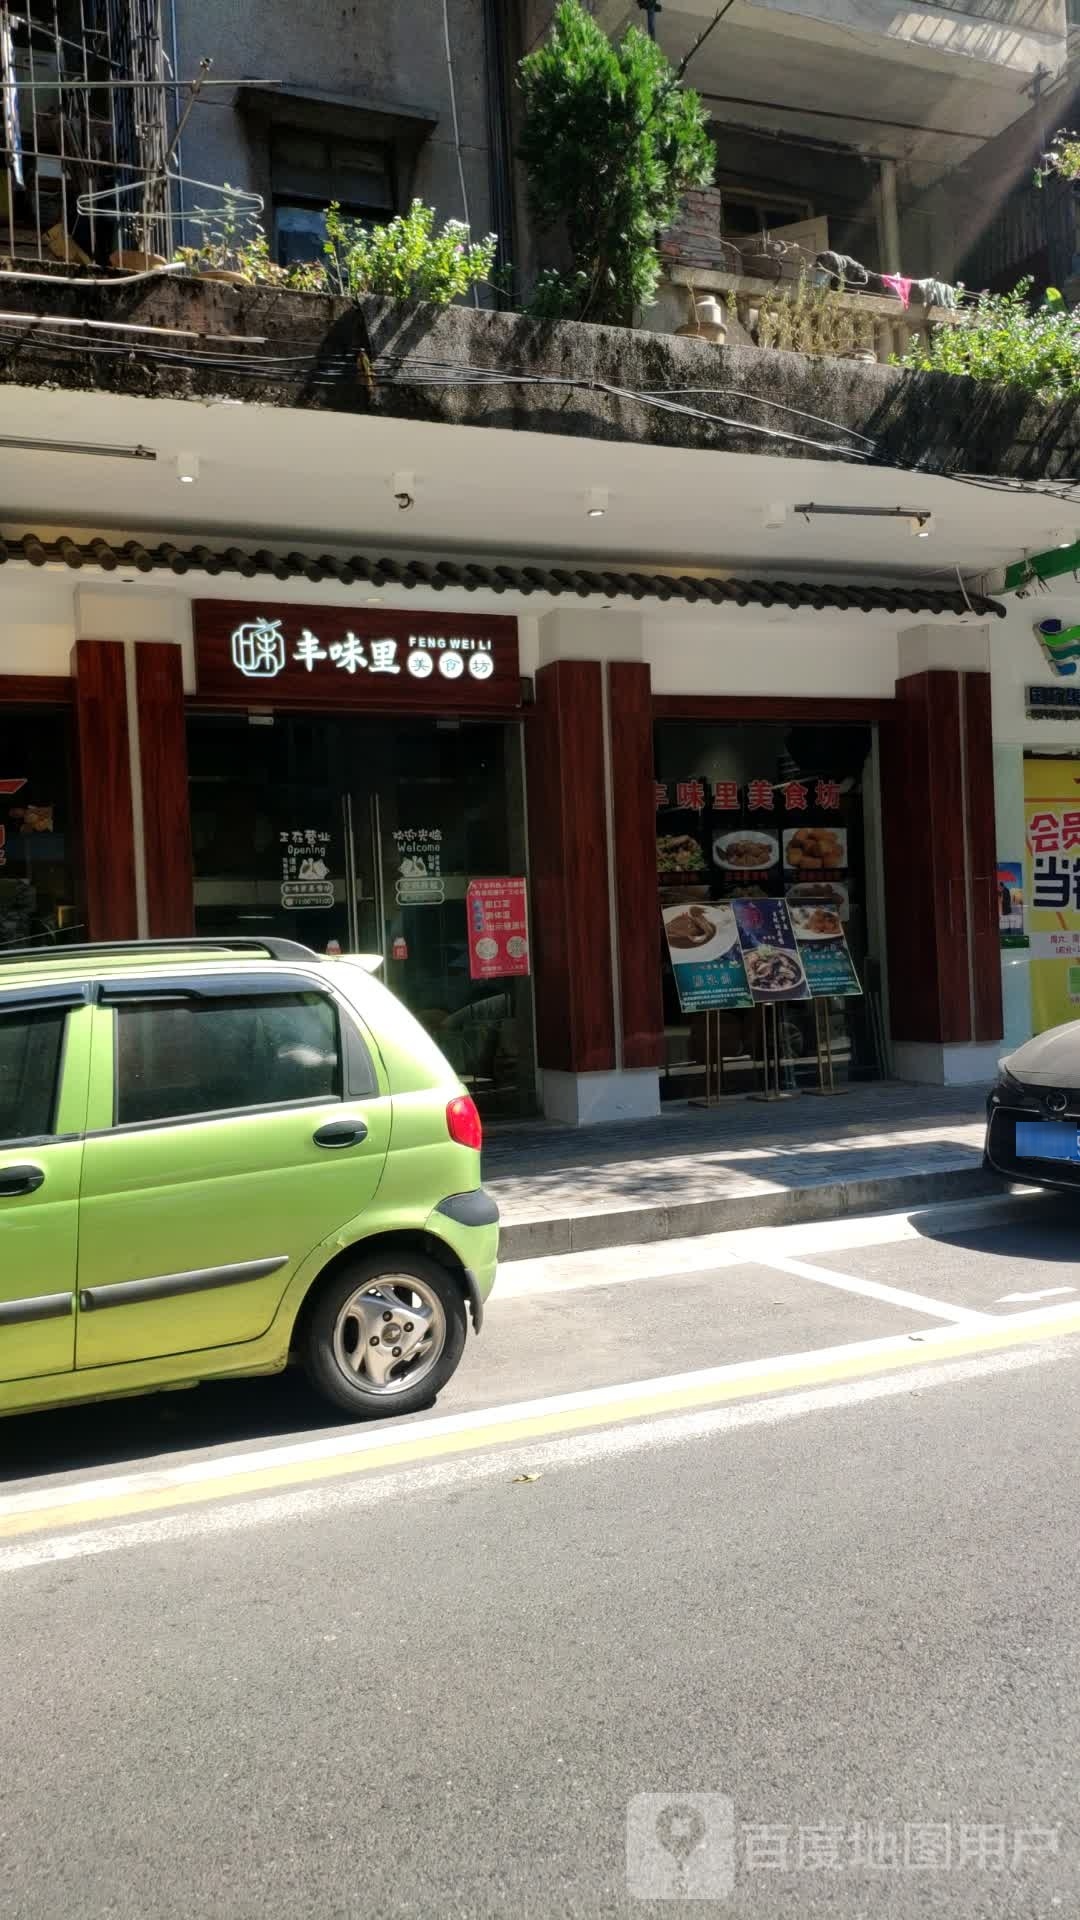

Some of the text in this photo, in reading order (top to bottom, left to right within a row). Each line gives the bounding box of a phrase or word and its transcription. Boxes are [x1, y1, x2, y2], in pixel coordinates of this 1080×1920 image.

[292, 629, 401, 674] 丰味里
[409, 636, 446, 649] FENG
[409, 655, 492, 676] 美食坊
[1030, 811, 1080, 853] 会员
[288, 844, 326, 857] Opening
[397, 841, 440, 853] Welcome
[1033, 855, 1080, 910] 当
